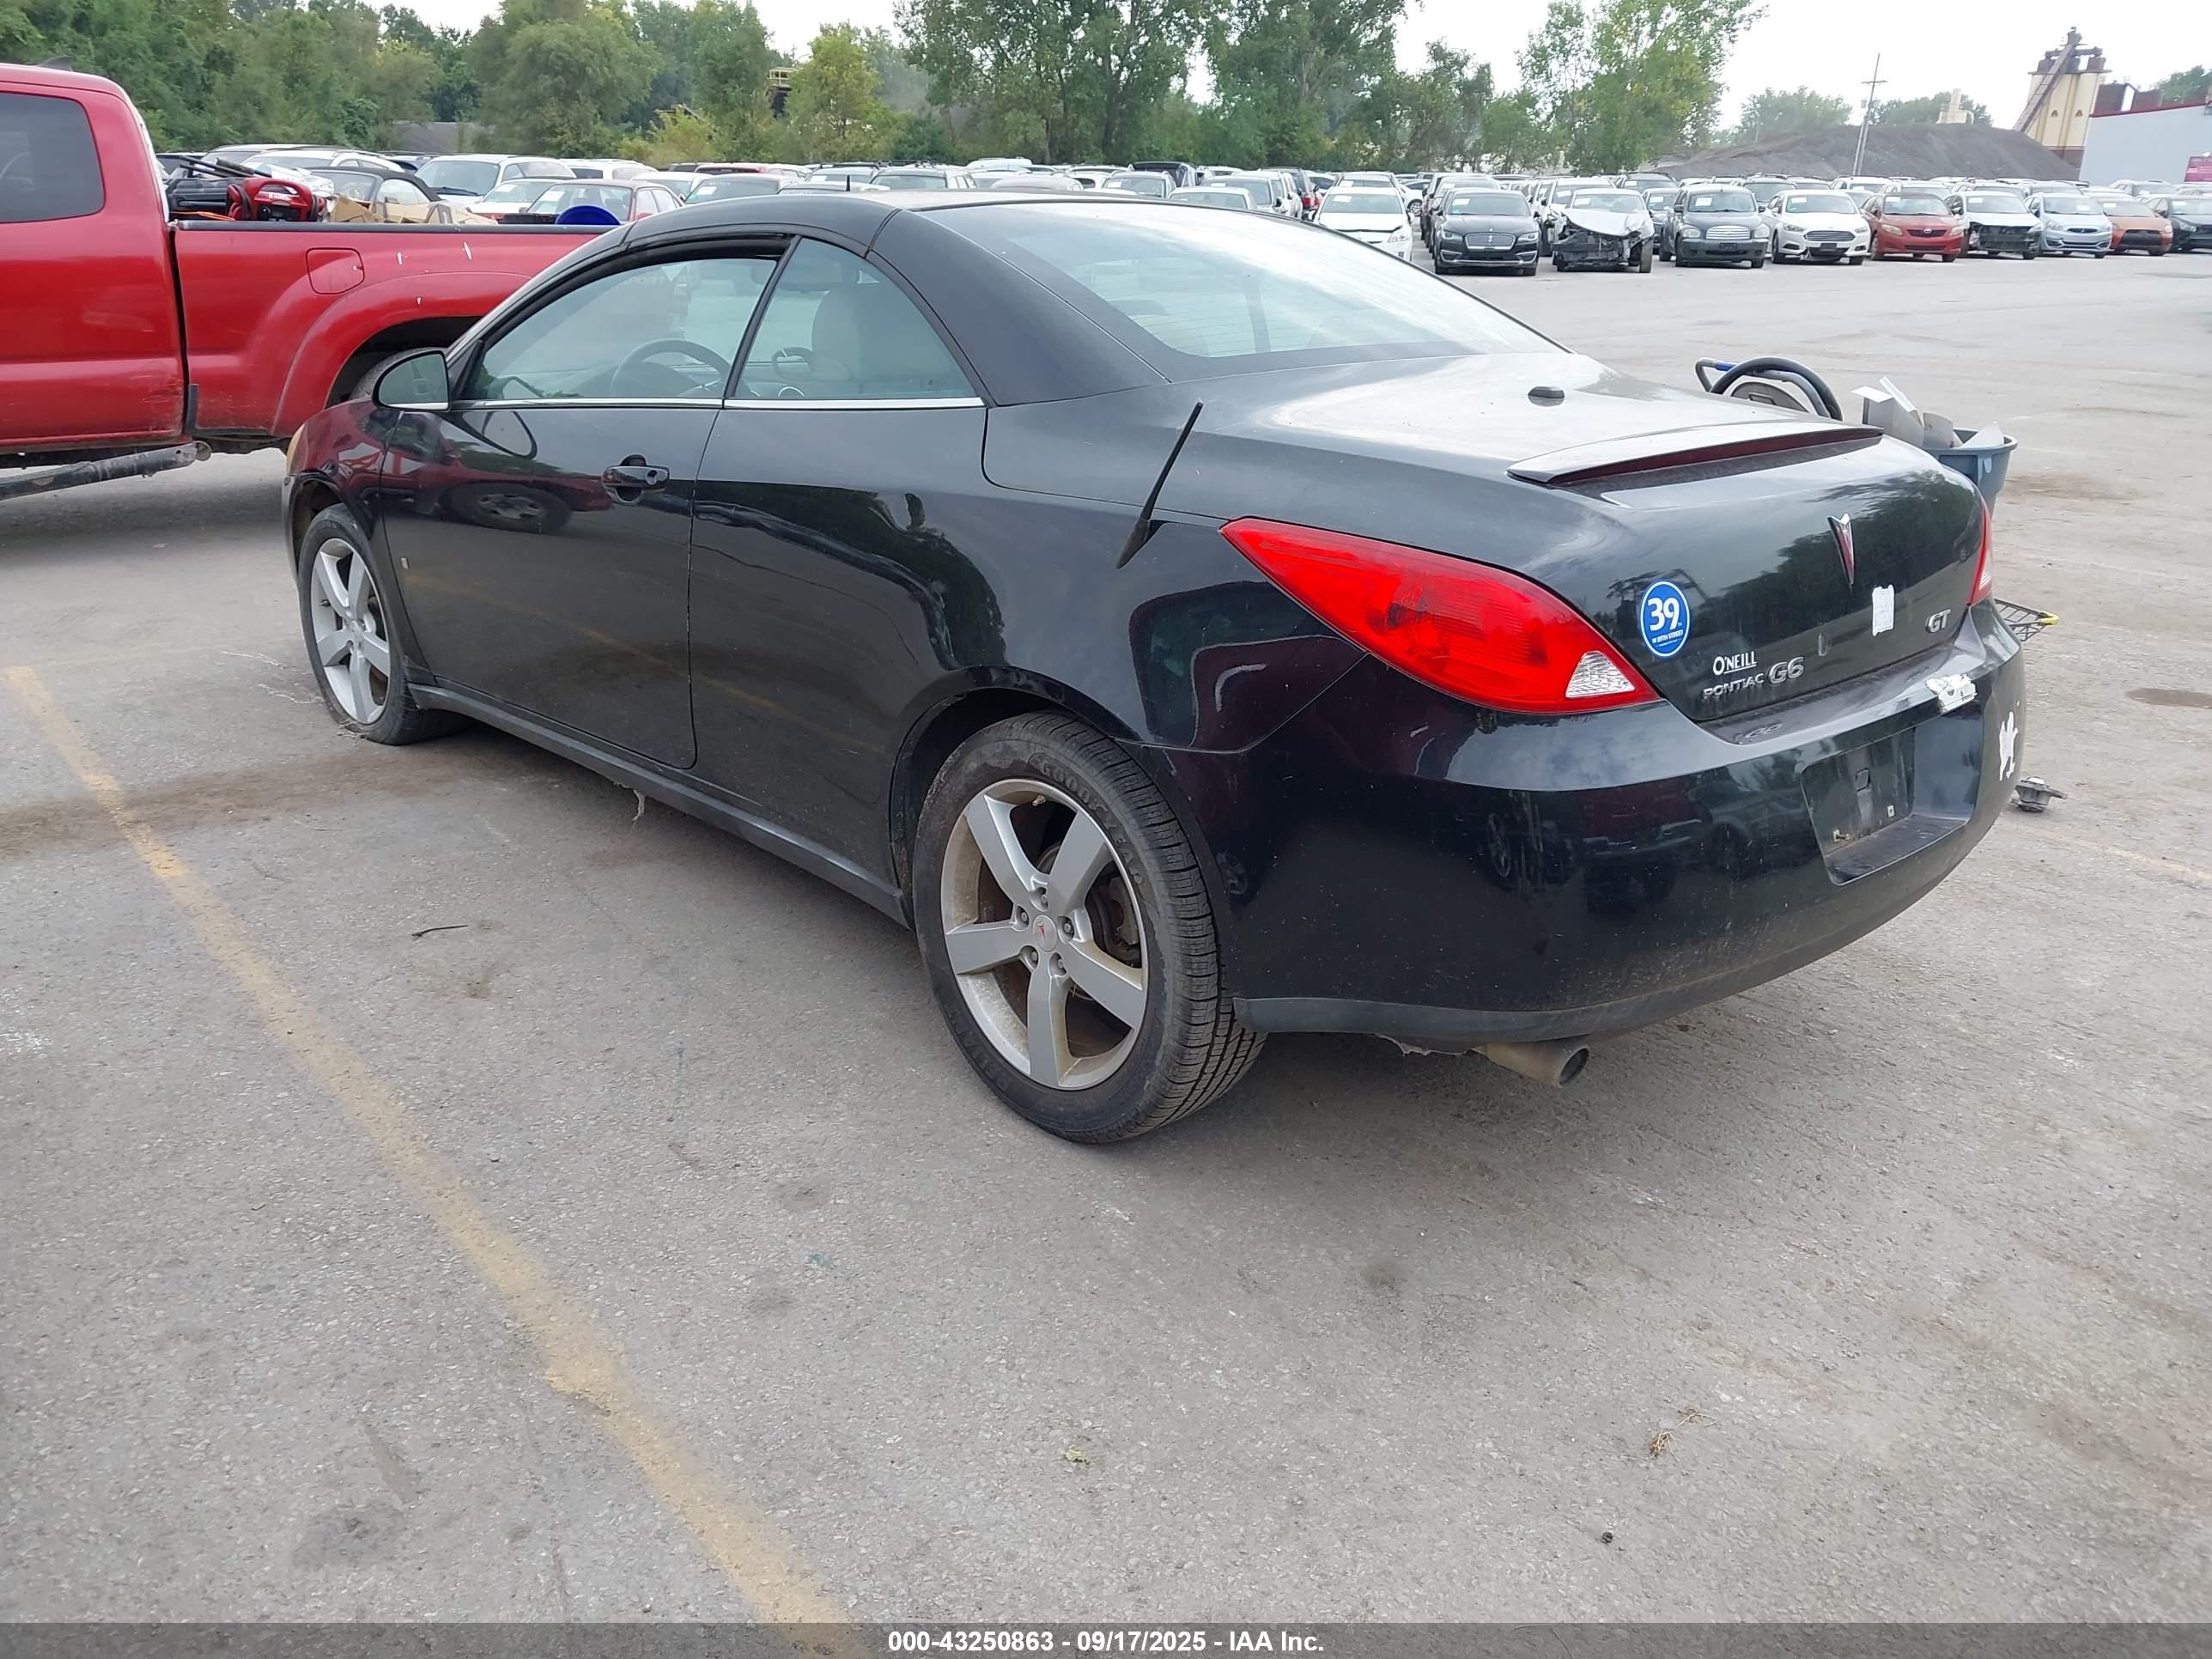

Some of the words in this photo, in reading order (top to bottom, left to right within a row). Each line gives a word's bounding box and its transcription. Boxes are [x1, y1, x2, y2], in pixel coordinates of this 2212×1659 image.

[1647, 597, 1680, 632] 39
[1925, 609, 1951, 633] GT
[1703, 673, 1765, 700] PONTIAC
[1768, 656, 1805, 684] G6
[1712, 650, 1759, 676] O'NEILL
